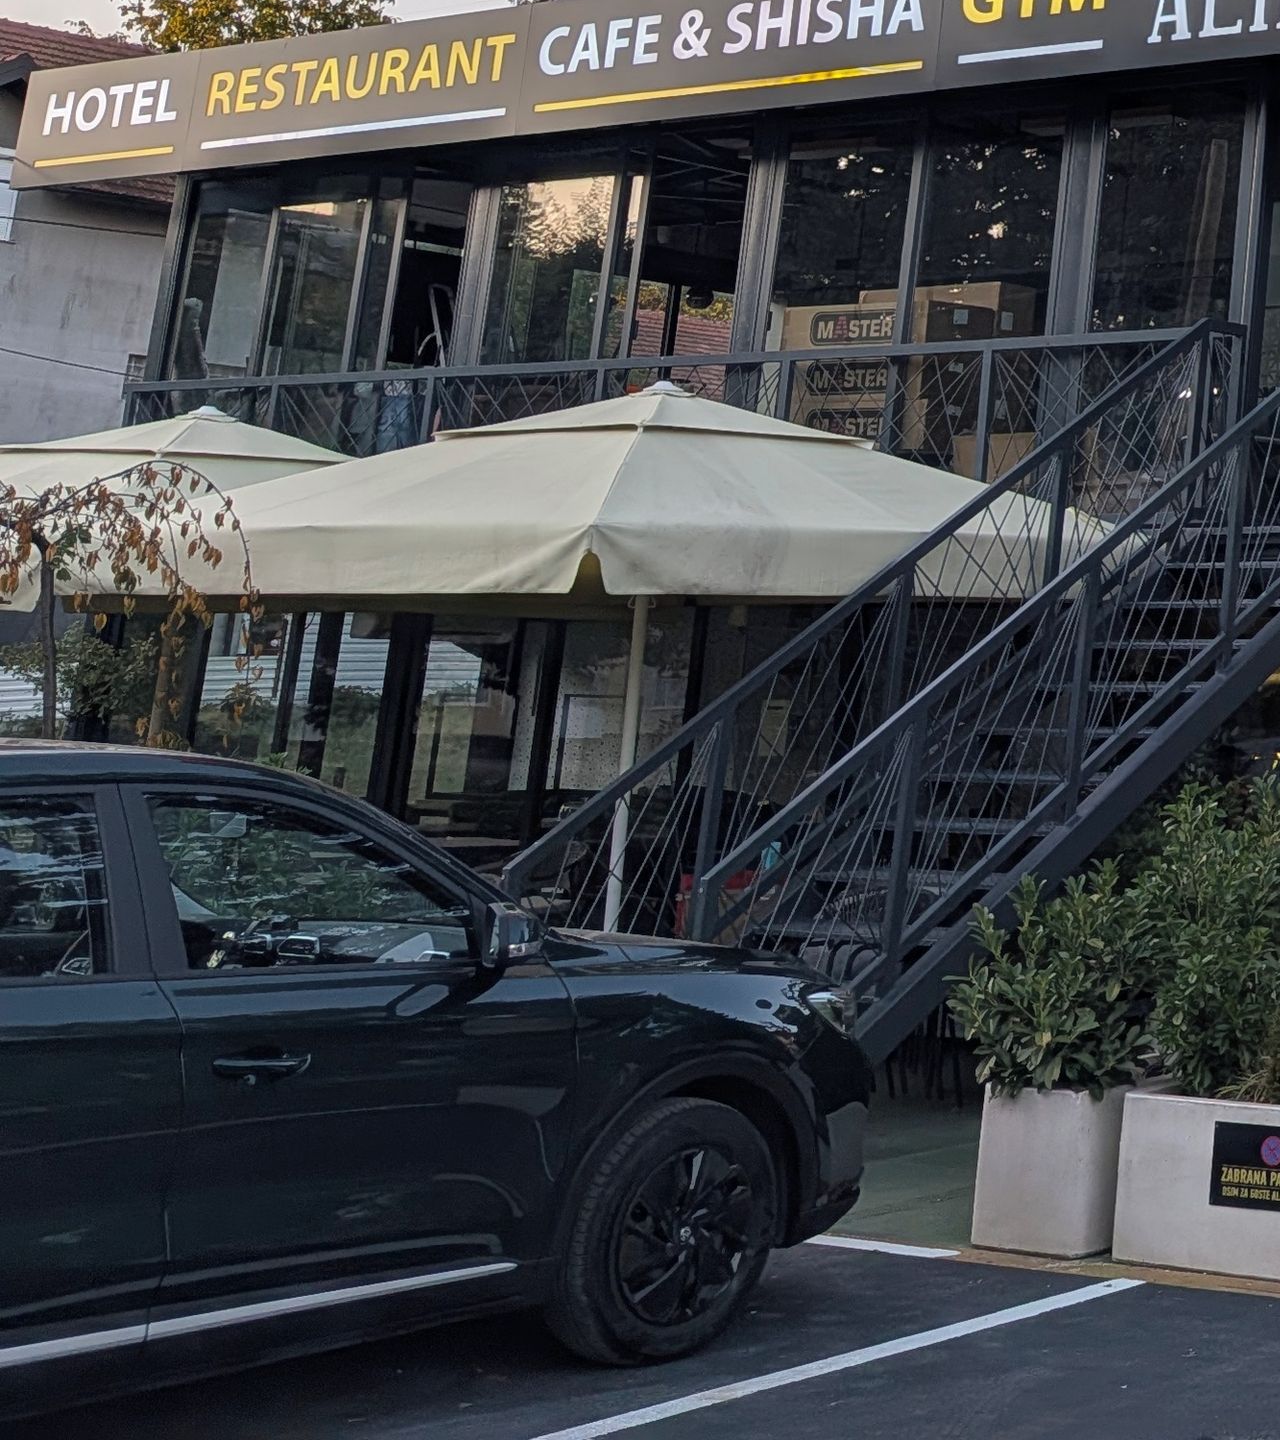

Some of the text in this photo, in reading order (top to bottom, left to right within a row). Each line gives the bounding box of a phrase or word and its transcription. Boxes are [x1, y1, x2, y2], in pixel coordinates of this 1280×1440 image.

[538, 14, 663, 76] CAFE
[672, 8, 712, 60] &
[205, 33, 517, 118] RESTAURANT
[41, 78, 178, 137] HOTEL
[816, 315, 894, 340] MASTER
[813, 367, 888, 390] MSTER
[1220, 1166, 1267, 1186] ZABRANA
